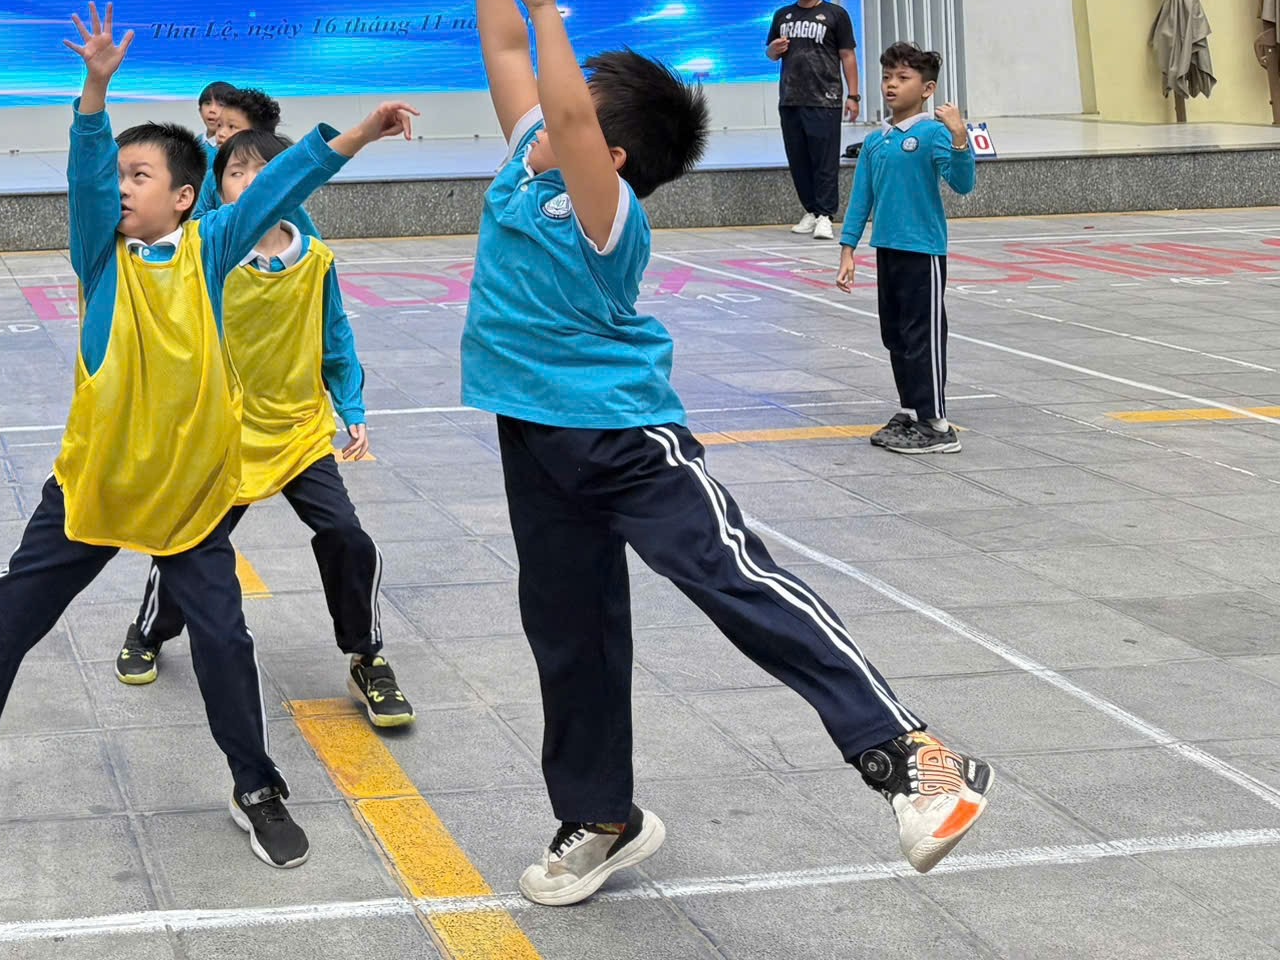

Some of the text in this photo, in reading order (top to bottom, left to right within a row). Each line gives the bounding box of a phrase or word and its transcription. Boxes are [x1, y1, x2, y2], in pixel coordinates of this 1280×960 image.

[248, 19, 303, 39] ngày
[313, 16, 337, 34] 16
[345, 14, 410, 35] tháng
[421, 14, 442, 31] 11
[780, 20, 827, 45] DRAGON
[974, 134, 990, 150] 0
